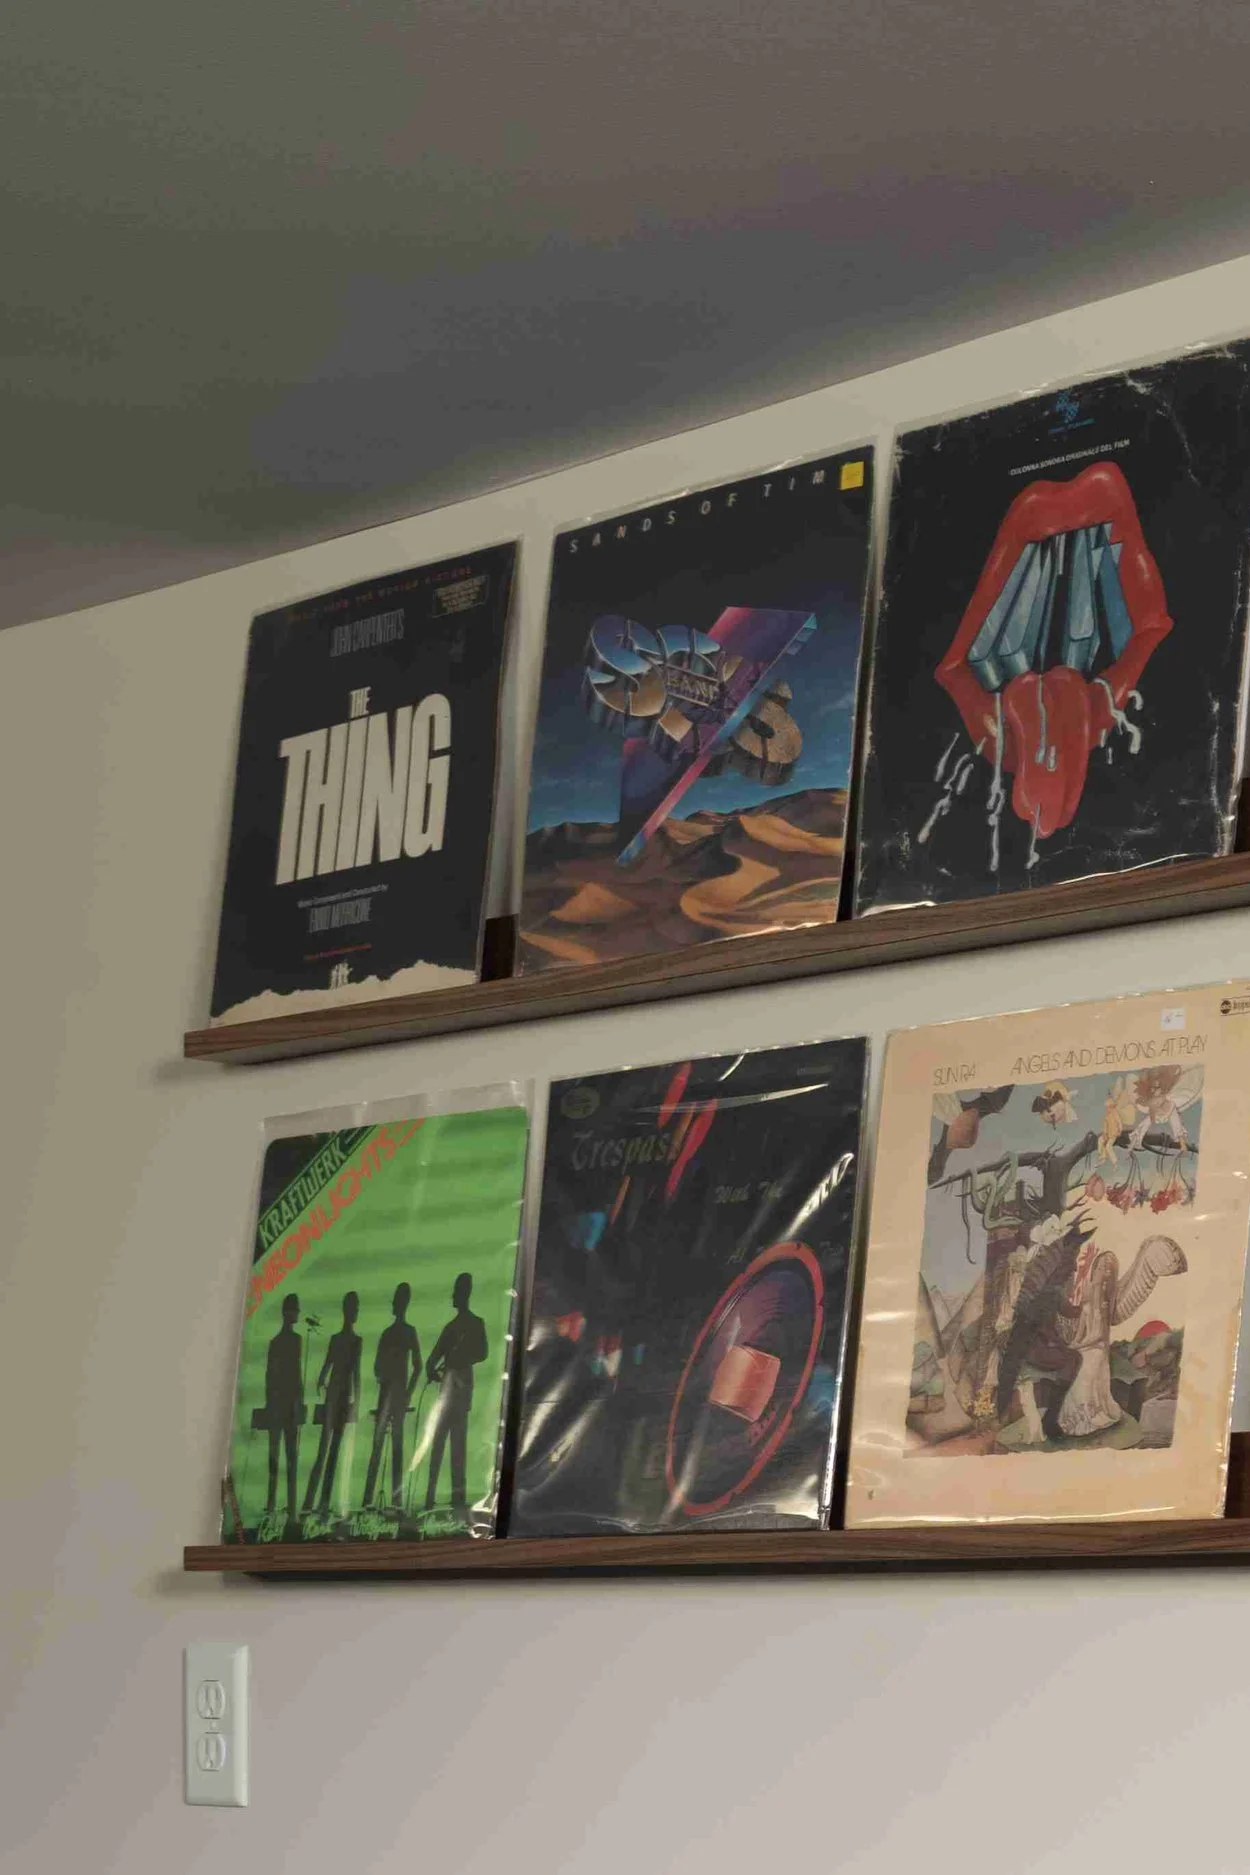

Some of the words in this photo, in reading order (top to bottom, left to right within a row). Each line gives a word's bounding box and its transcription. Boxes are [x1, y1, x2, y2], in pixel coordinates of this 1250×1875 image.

[567, 509, 679, 554] SANDS
[699, 492, 739, 516] OF
[762, 469, 827, 497] TIM
[349, 687, 371, 716] THE
[275, 692, 452, 886] THING
[933, 1066, 960, 1087] SUN
[960, 1063, 977, 1084] RA
[1009, 1052, 1063, 1077] ANGELS
[1063, 1048, 1093, 1069] AND
[1095, 1040, 1157, 1066] DEMONS
[1160, 1038, 1178, 1057] AT
[1178, 1034, 1208, 1055] PLAY
[257, 1136, 347, 1247] KRAFTWERK
